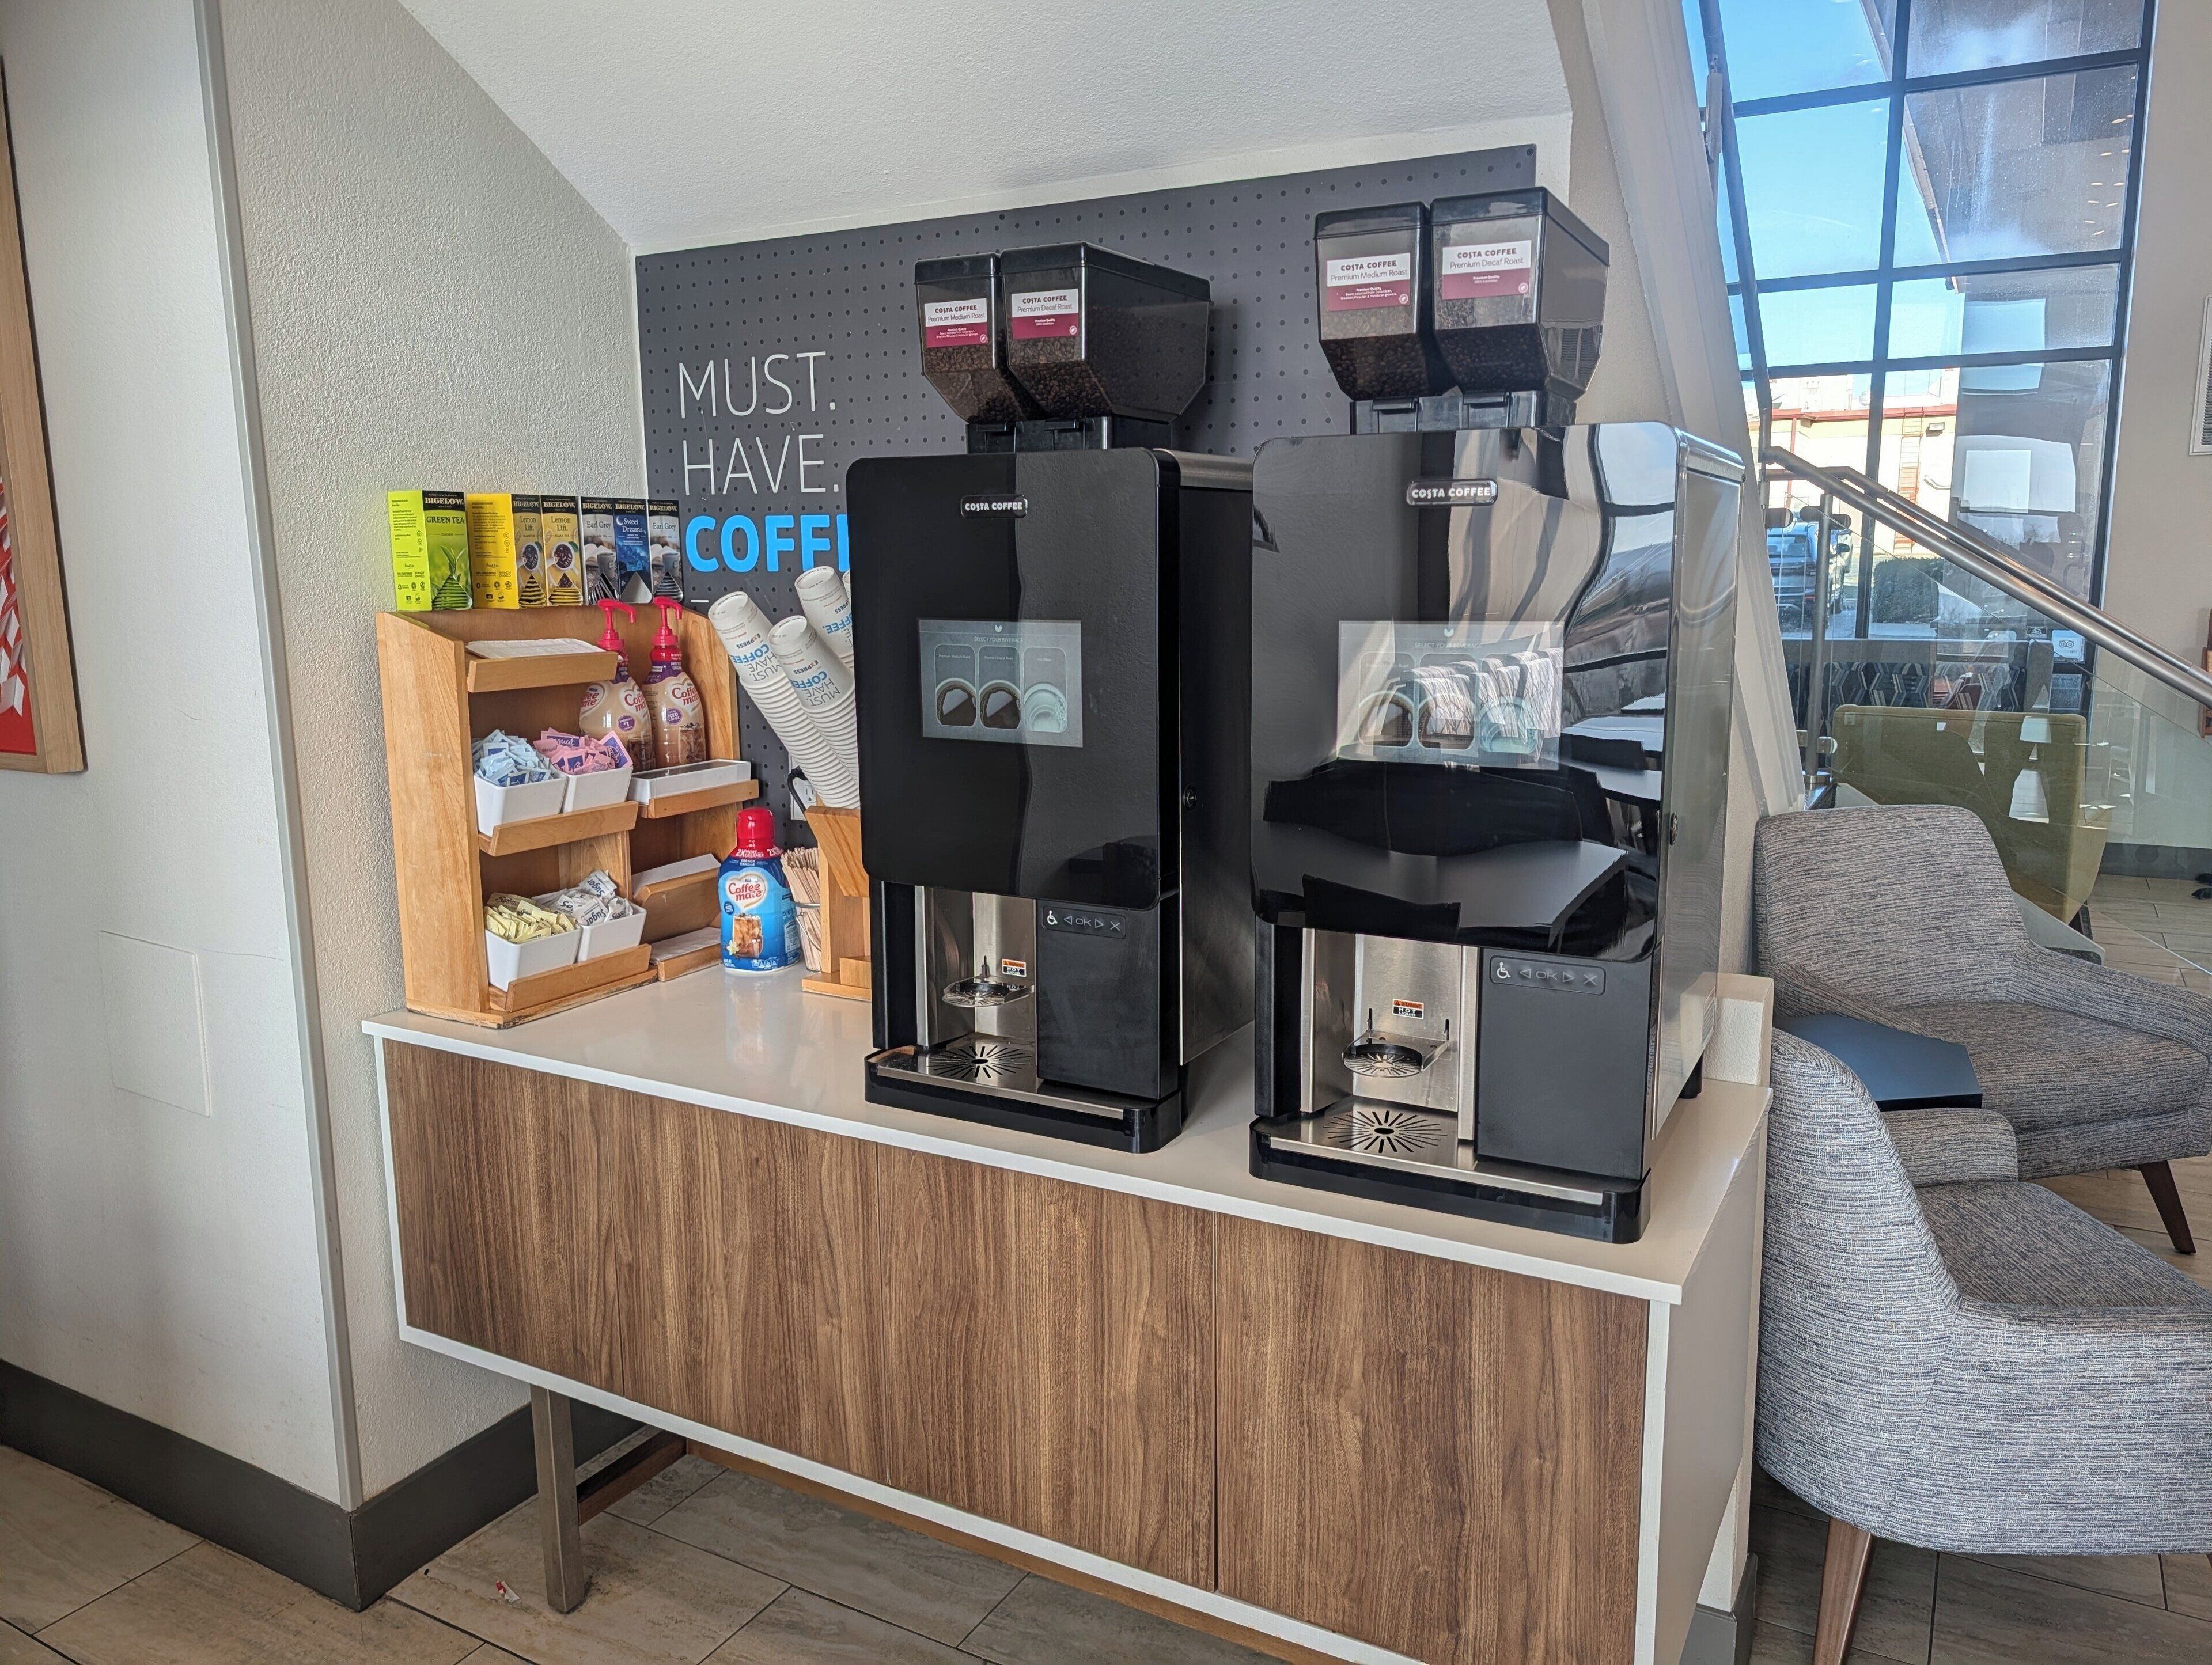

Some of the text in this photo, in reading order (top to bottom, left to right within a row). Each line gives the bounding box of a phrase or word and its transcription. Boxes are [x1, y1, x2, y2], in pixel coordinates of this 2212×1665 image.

[1457, 248, 1517, 259] COSTA COFFEE
[1341, 260, 1397, 271] COSTA COFFEE
[679, 351, 836, 419] MUST.
[683, 434, 839, 495] HAVE.
[1412, 487, 1491, 499] COSTA COFFEE
[965, 502, 1022, 511] COSTA COFFEE
[599, 521, 611, 530] Grey
[736, 633, 761, 649] EXPRESS
[744, 652, 777, 672] HAVE.
[793, 659, 819, 674] EXPRESS
[749, 664, 782, 681] MUST.
[801, 678, 834, 697] HAVE.
[806, 687, 840, 706] MUST.
[586, 879, 605, 897] Sugar
[728, 882, 760, 894] Coffee
[736, 890, 762, 901] mate
[585, 909, 606, 926] Sugar
[1076, 917, 1092, 926] OK
[1536, 971, 1558, 980] OK
